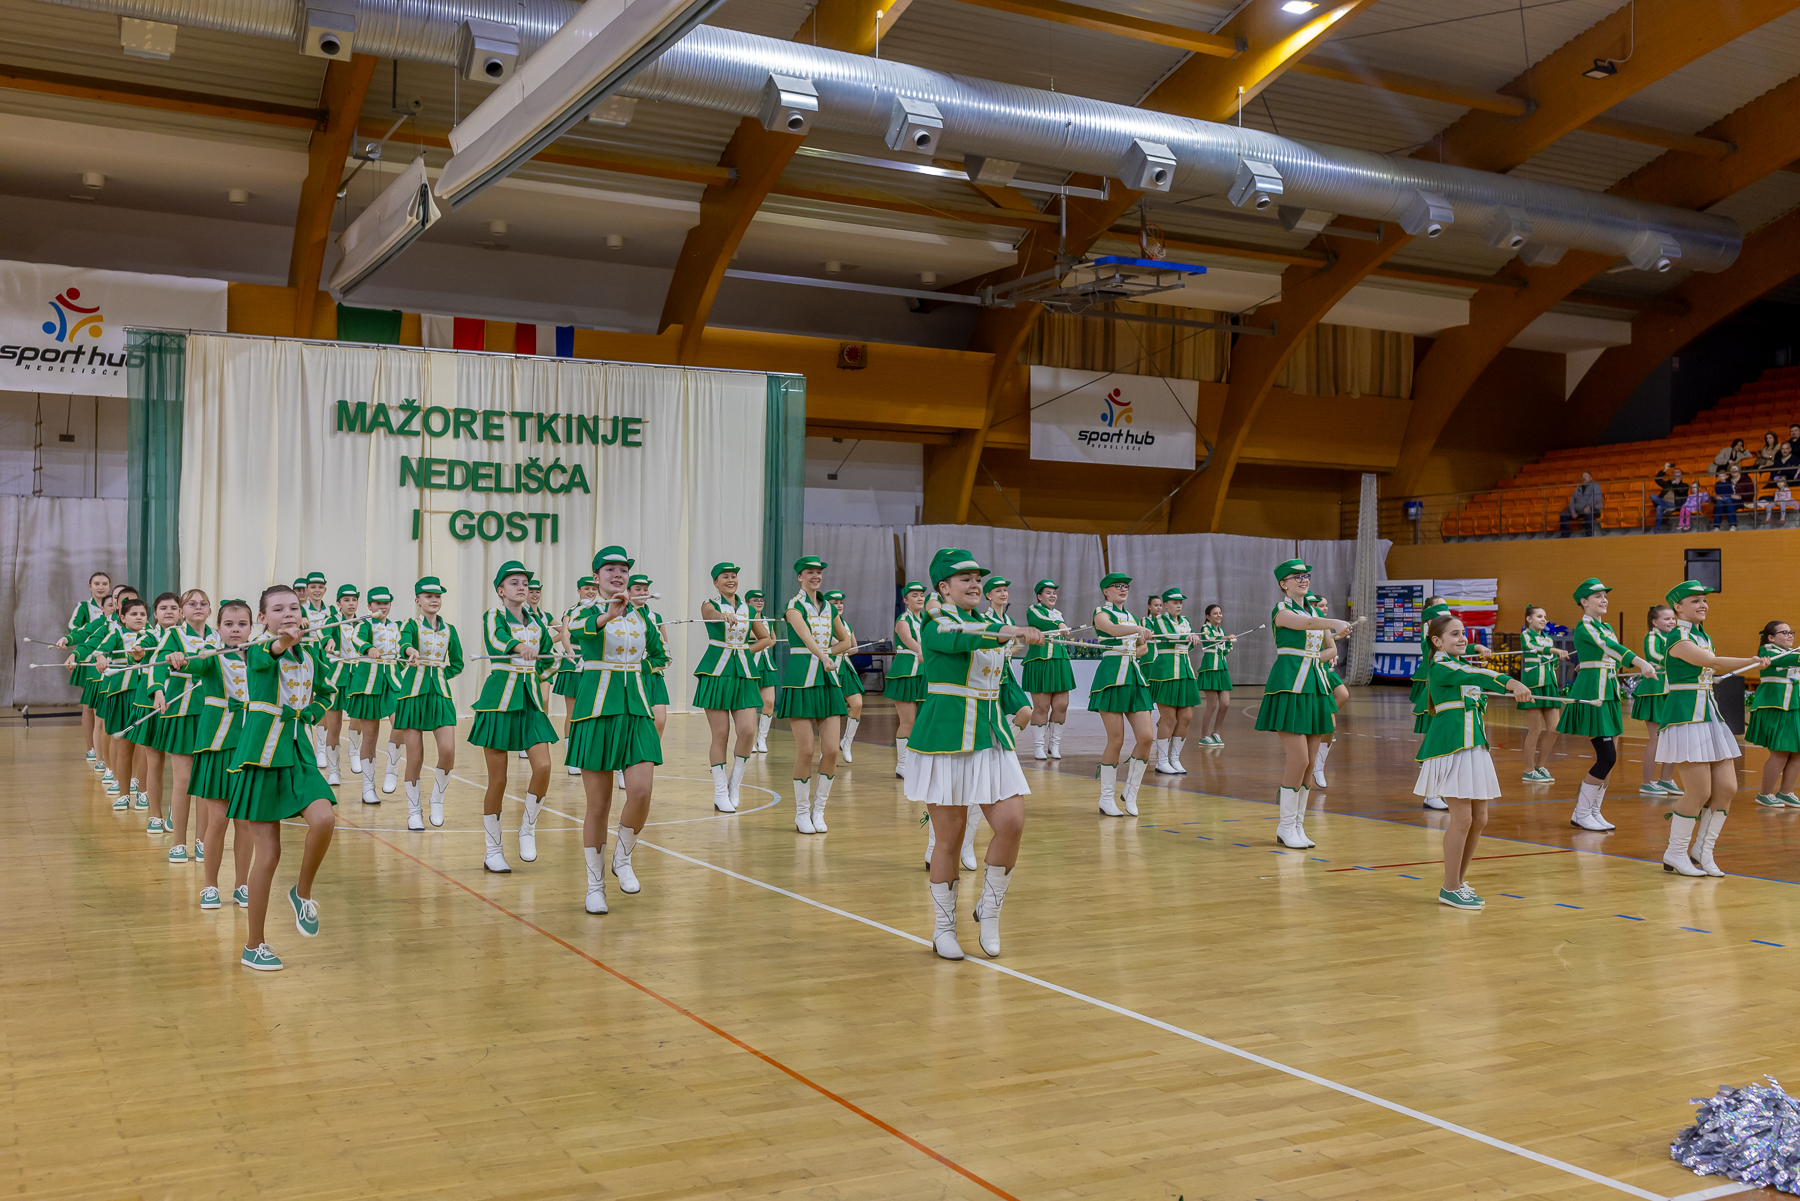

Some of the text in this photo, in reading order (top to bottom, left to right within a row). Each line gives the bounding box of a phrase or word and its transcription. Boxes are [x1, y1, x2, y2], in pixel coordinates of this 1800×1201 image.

[0, 344, 86, 366] sport
[336, 398, 643, 447] MAŽORETKINJE
[1078, 429, 1155, 445] sport hub
[399, 456, 591, 494] NEDELIŠĆA
[411, 509, 559, 544] I GOSTI
